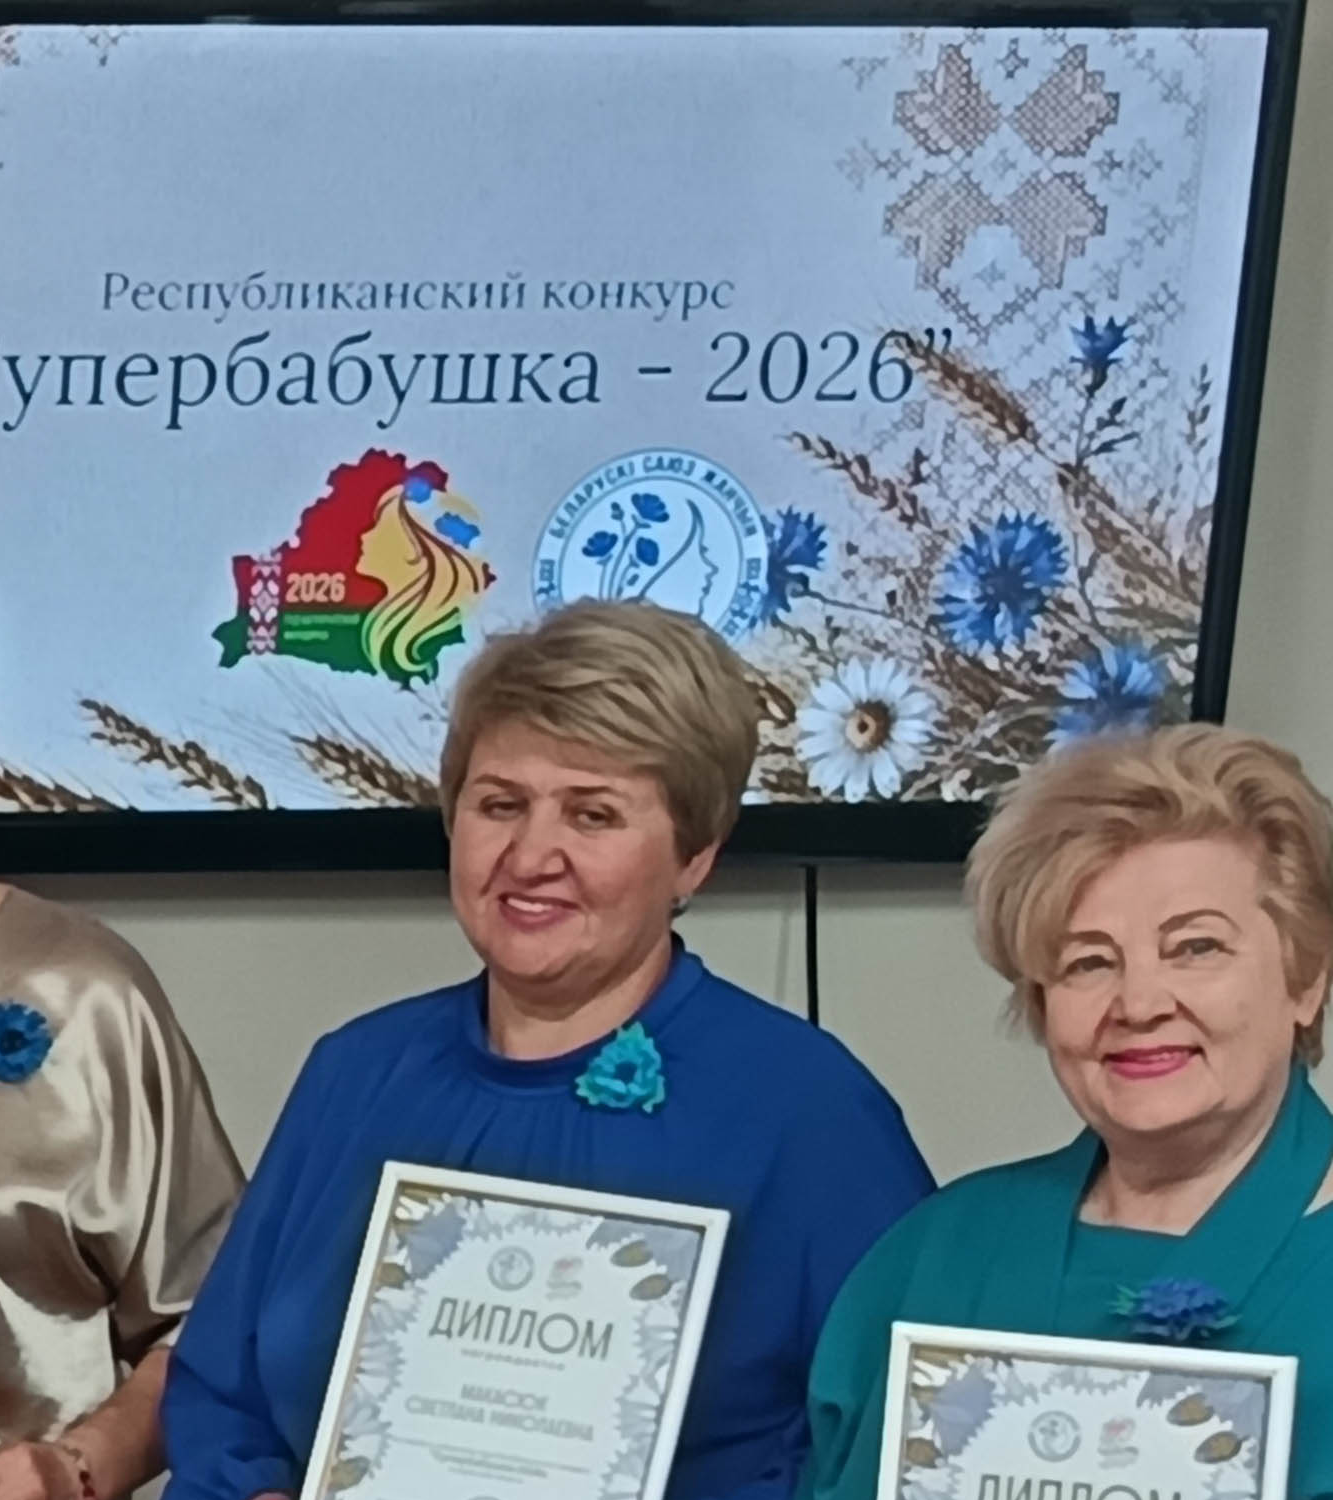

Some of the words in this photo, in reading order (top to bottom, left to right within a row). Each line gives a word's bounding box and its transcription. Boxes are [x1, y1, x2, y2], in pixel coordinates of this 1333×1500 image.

[102, 271, 526, 324] Республиканский
[542, 279, 736, 322] конкурс
[284, 572, 347, 603] 2026
[428, 1296, 615, 1361] ДИПЛОМ
